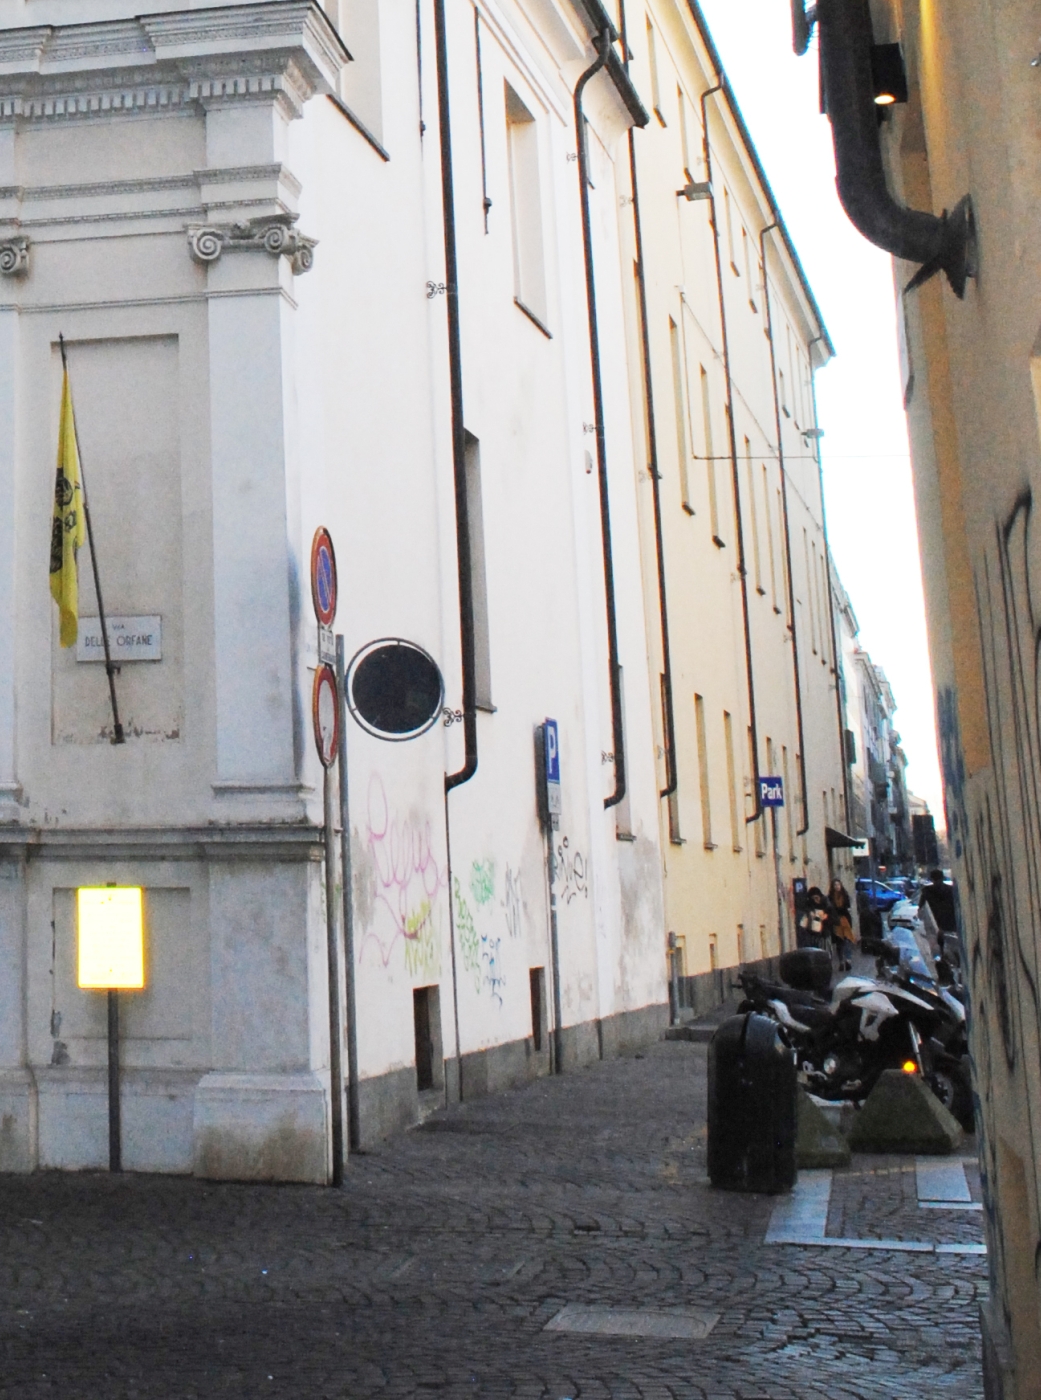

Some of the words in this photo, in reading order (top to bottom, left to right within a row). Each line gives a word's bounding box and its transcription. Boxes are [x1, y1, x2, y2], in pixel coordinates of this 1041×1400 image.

[117, 635, 152, 646] ORFANE
[547, 726, 556, 774] P
[761, 783, 782, 799] Park
